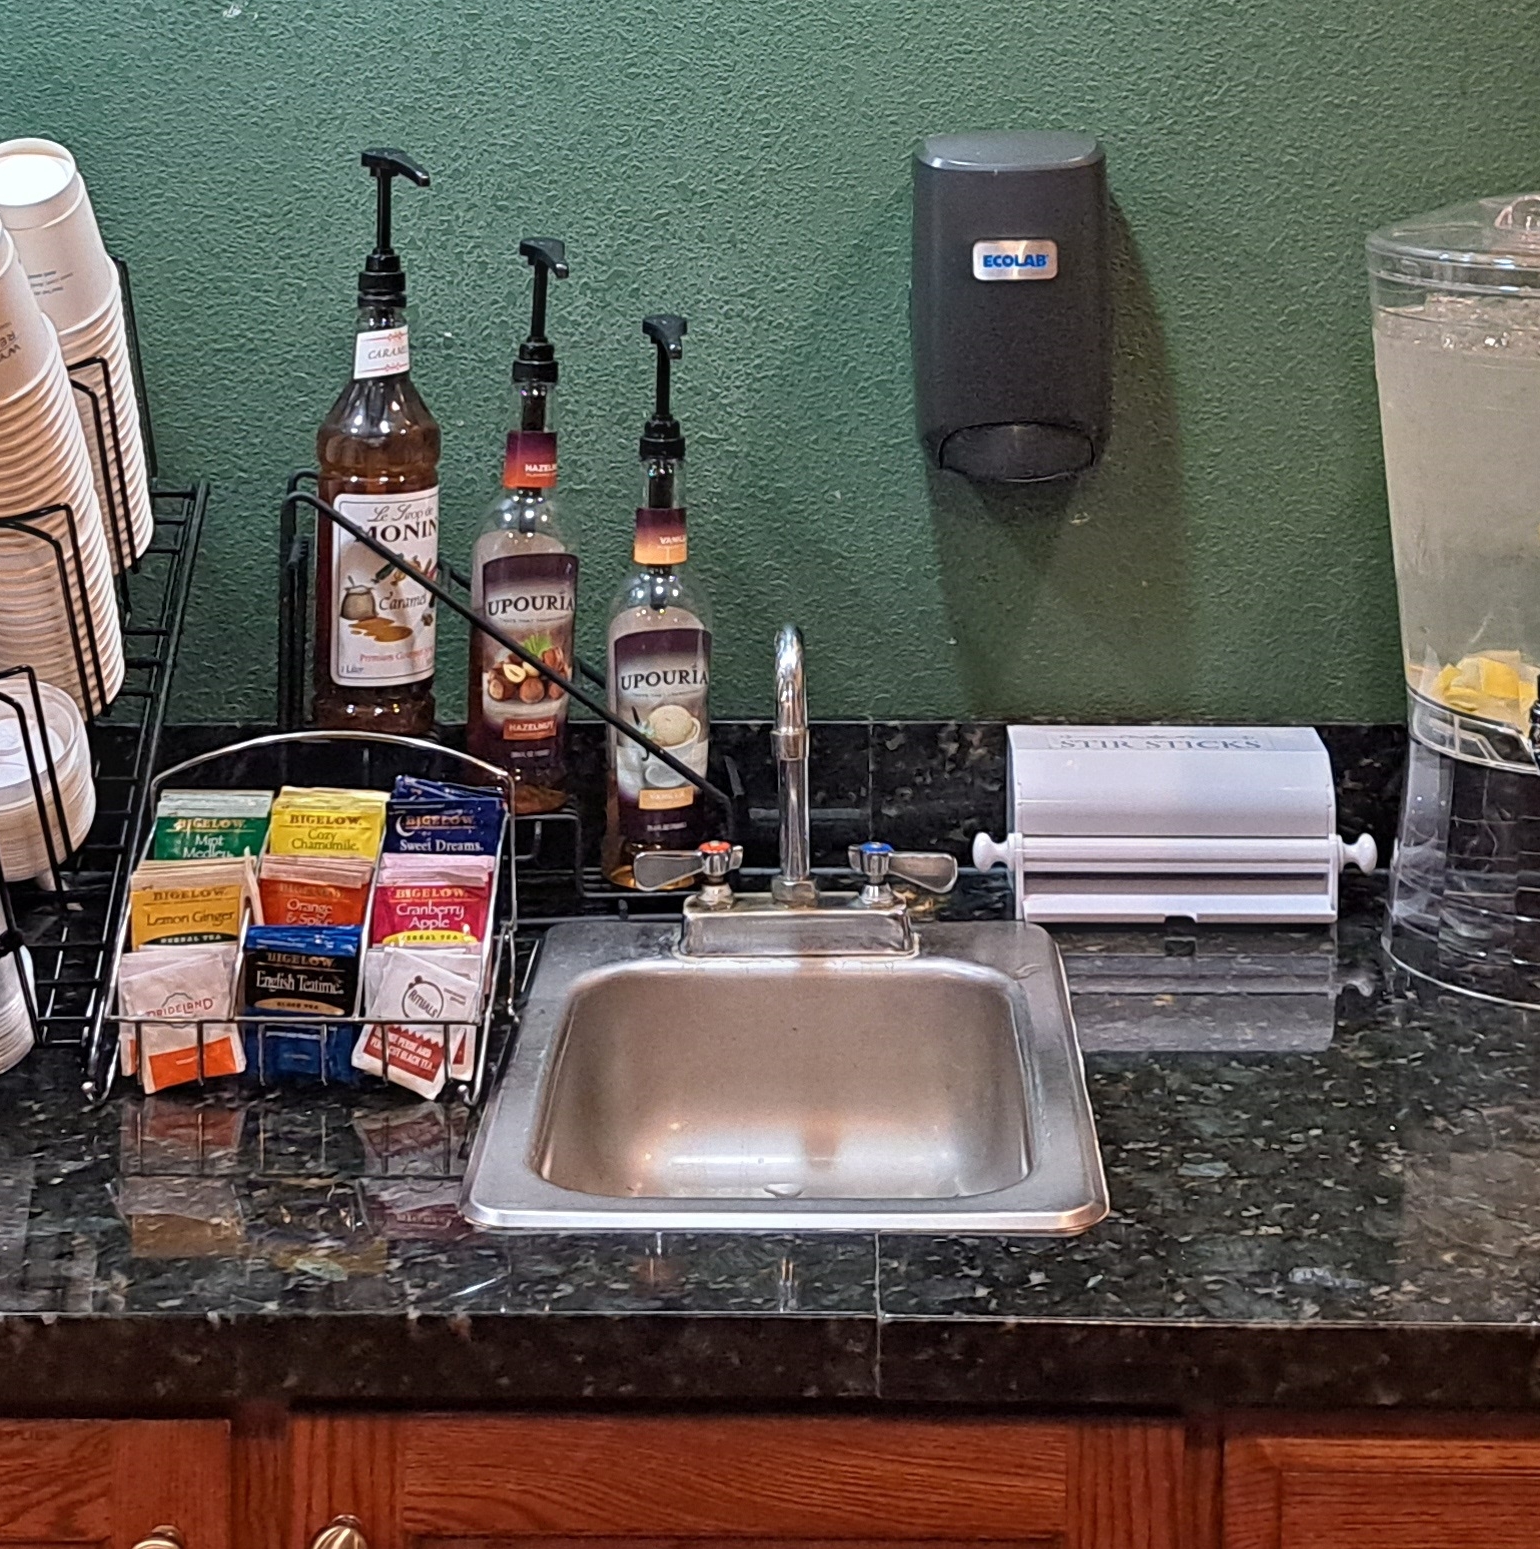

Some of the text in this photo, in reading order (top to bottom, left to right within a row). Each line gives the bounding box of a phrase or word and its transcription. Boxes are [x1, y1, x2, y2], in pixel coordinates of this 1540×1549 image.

[983, 254, 1048, 268] ECOLAB
[367, 505, 390, 522] Le
[392, 504, 423, 523] Sirop
[1060, 739, 1261, 750] STIR STICKS
[289, 814, 362, 826] BIGELOW
[195, 833, 225, 847] Mint
[308, 828, 337, 842] Cozy
[400, 838, 432, 851] Sweet
[153, 888, 227, 901] BIGELOW
[395, 888, 467, 899] BIGELOW
[286, 898, 333, 917] Orange
[396, 900, 464, 921] Cranberry
[146, 911, 235, 927] Lemon Ginger
[286, 911, 298, 924] &
[408, 913, 450, 931] Apple
[202, 934, 222, 942] TEA
[256, 970, 296, 992] English
[408, 989, 438, 1018] RITUALS
